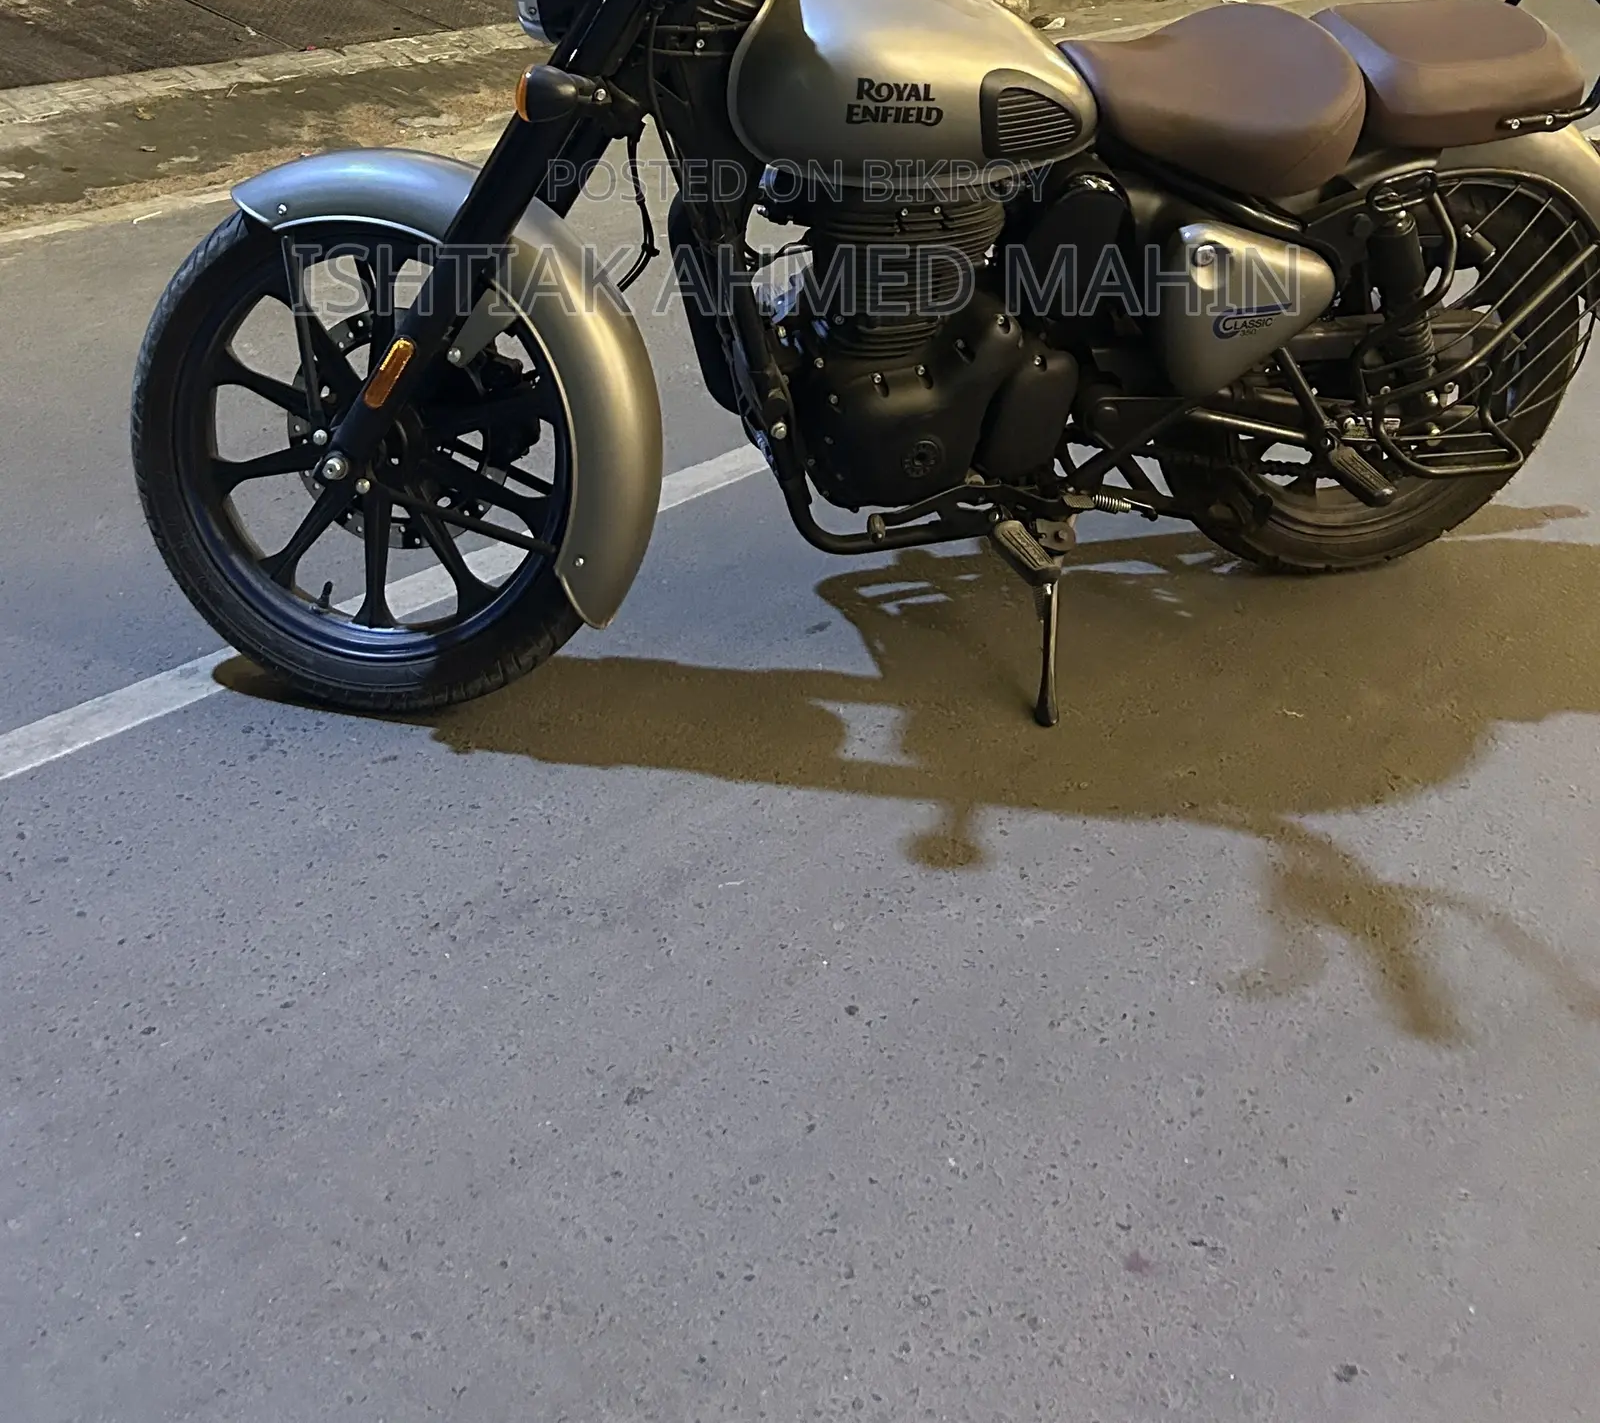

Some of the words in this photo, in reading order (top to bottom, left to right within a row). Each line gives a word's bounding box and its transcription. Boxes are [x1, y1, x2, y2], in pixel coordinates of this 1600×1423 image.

[856, 77, 936, 103] ROYAL
[845, 103, 944, 127] ENFIELD
[1221, 317, 1274, 331] CLASSIC
